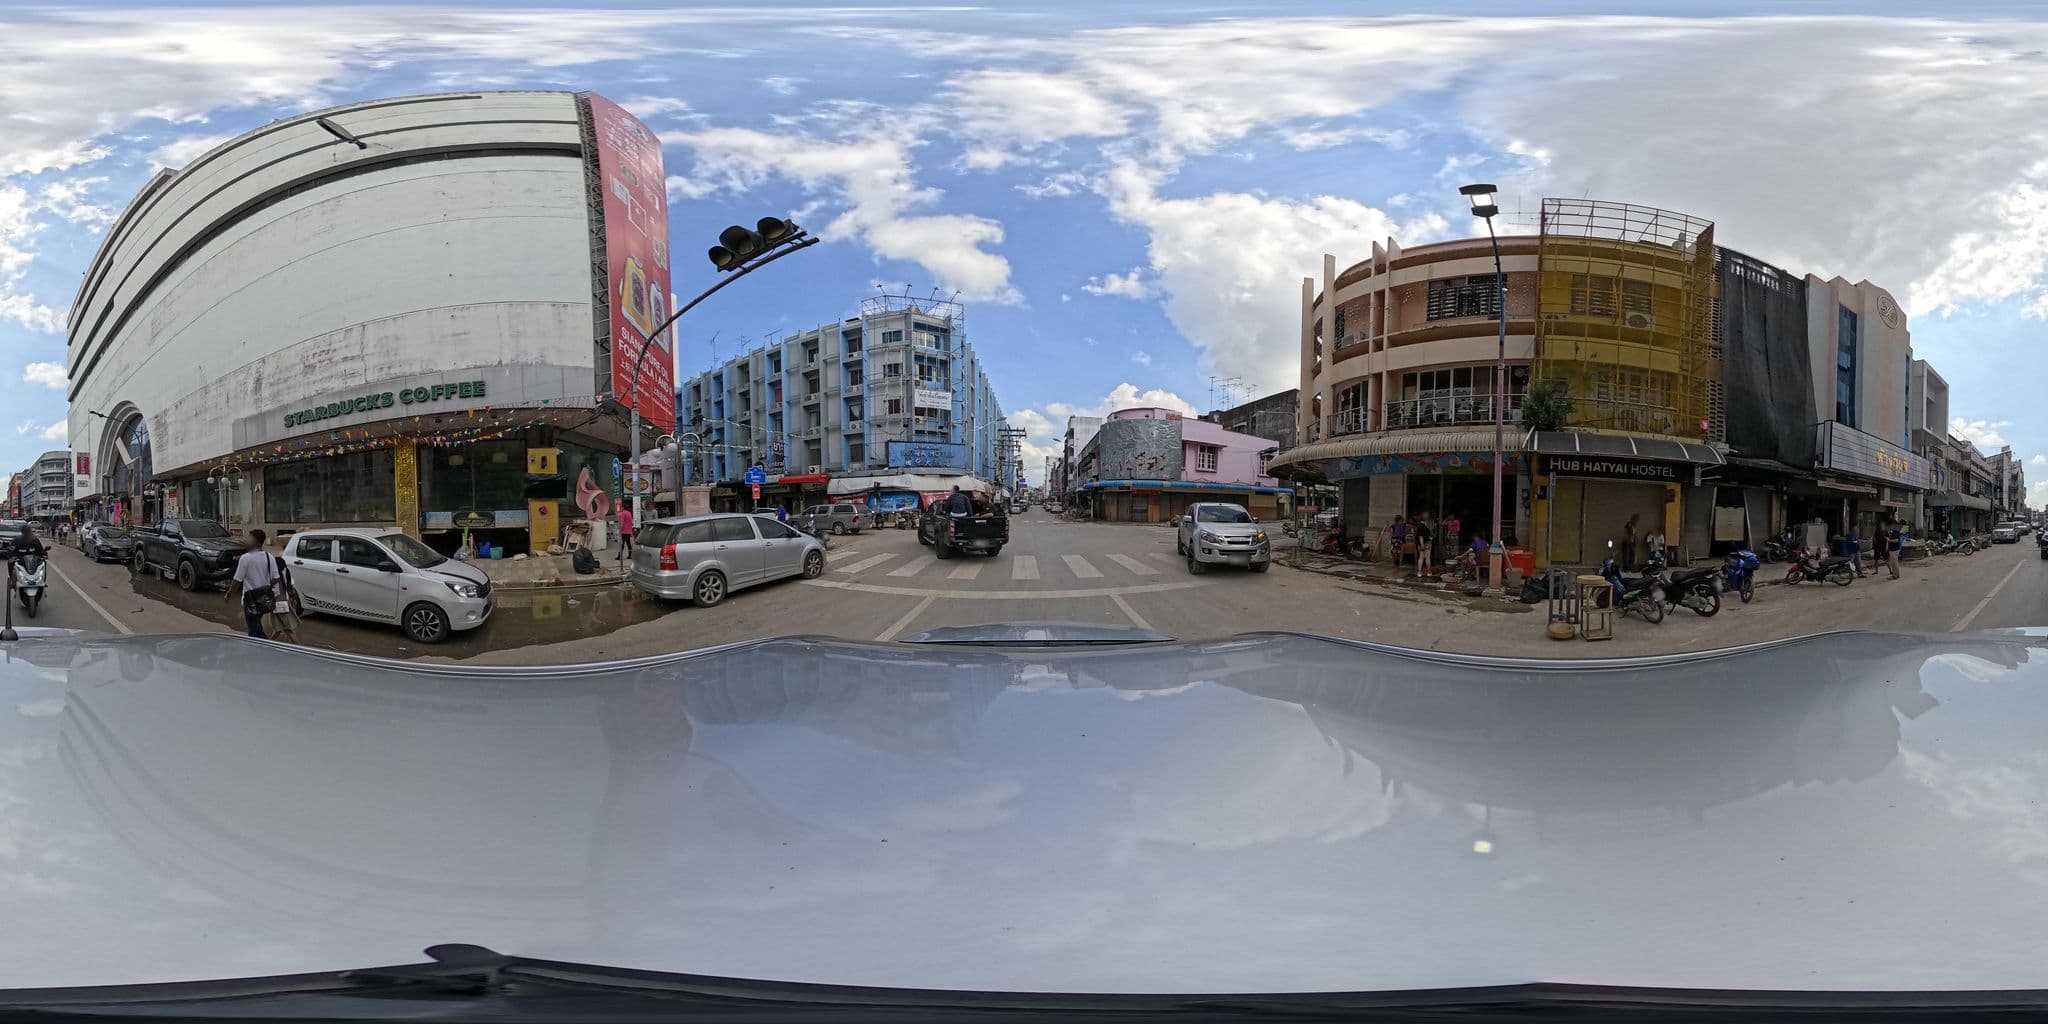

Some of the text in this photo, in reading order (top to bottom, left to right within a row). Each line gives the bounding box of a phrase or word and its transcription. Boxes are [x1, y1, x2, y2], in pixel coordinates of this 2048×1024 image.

[283, 380, 486, 428] STARBUCKS COFFEE
[1550, 457, 1676, 478] HUB HATYAI HOSTEL
